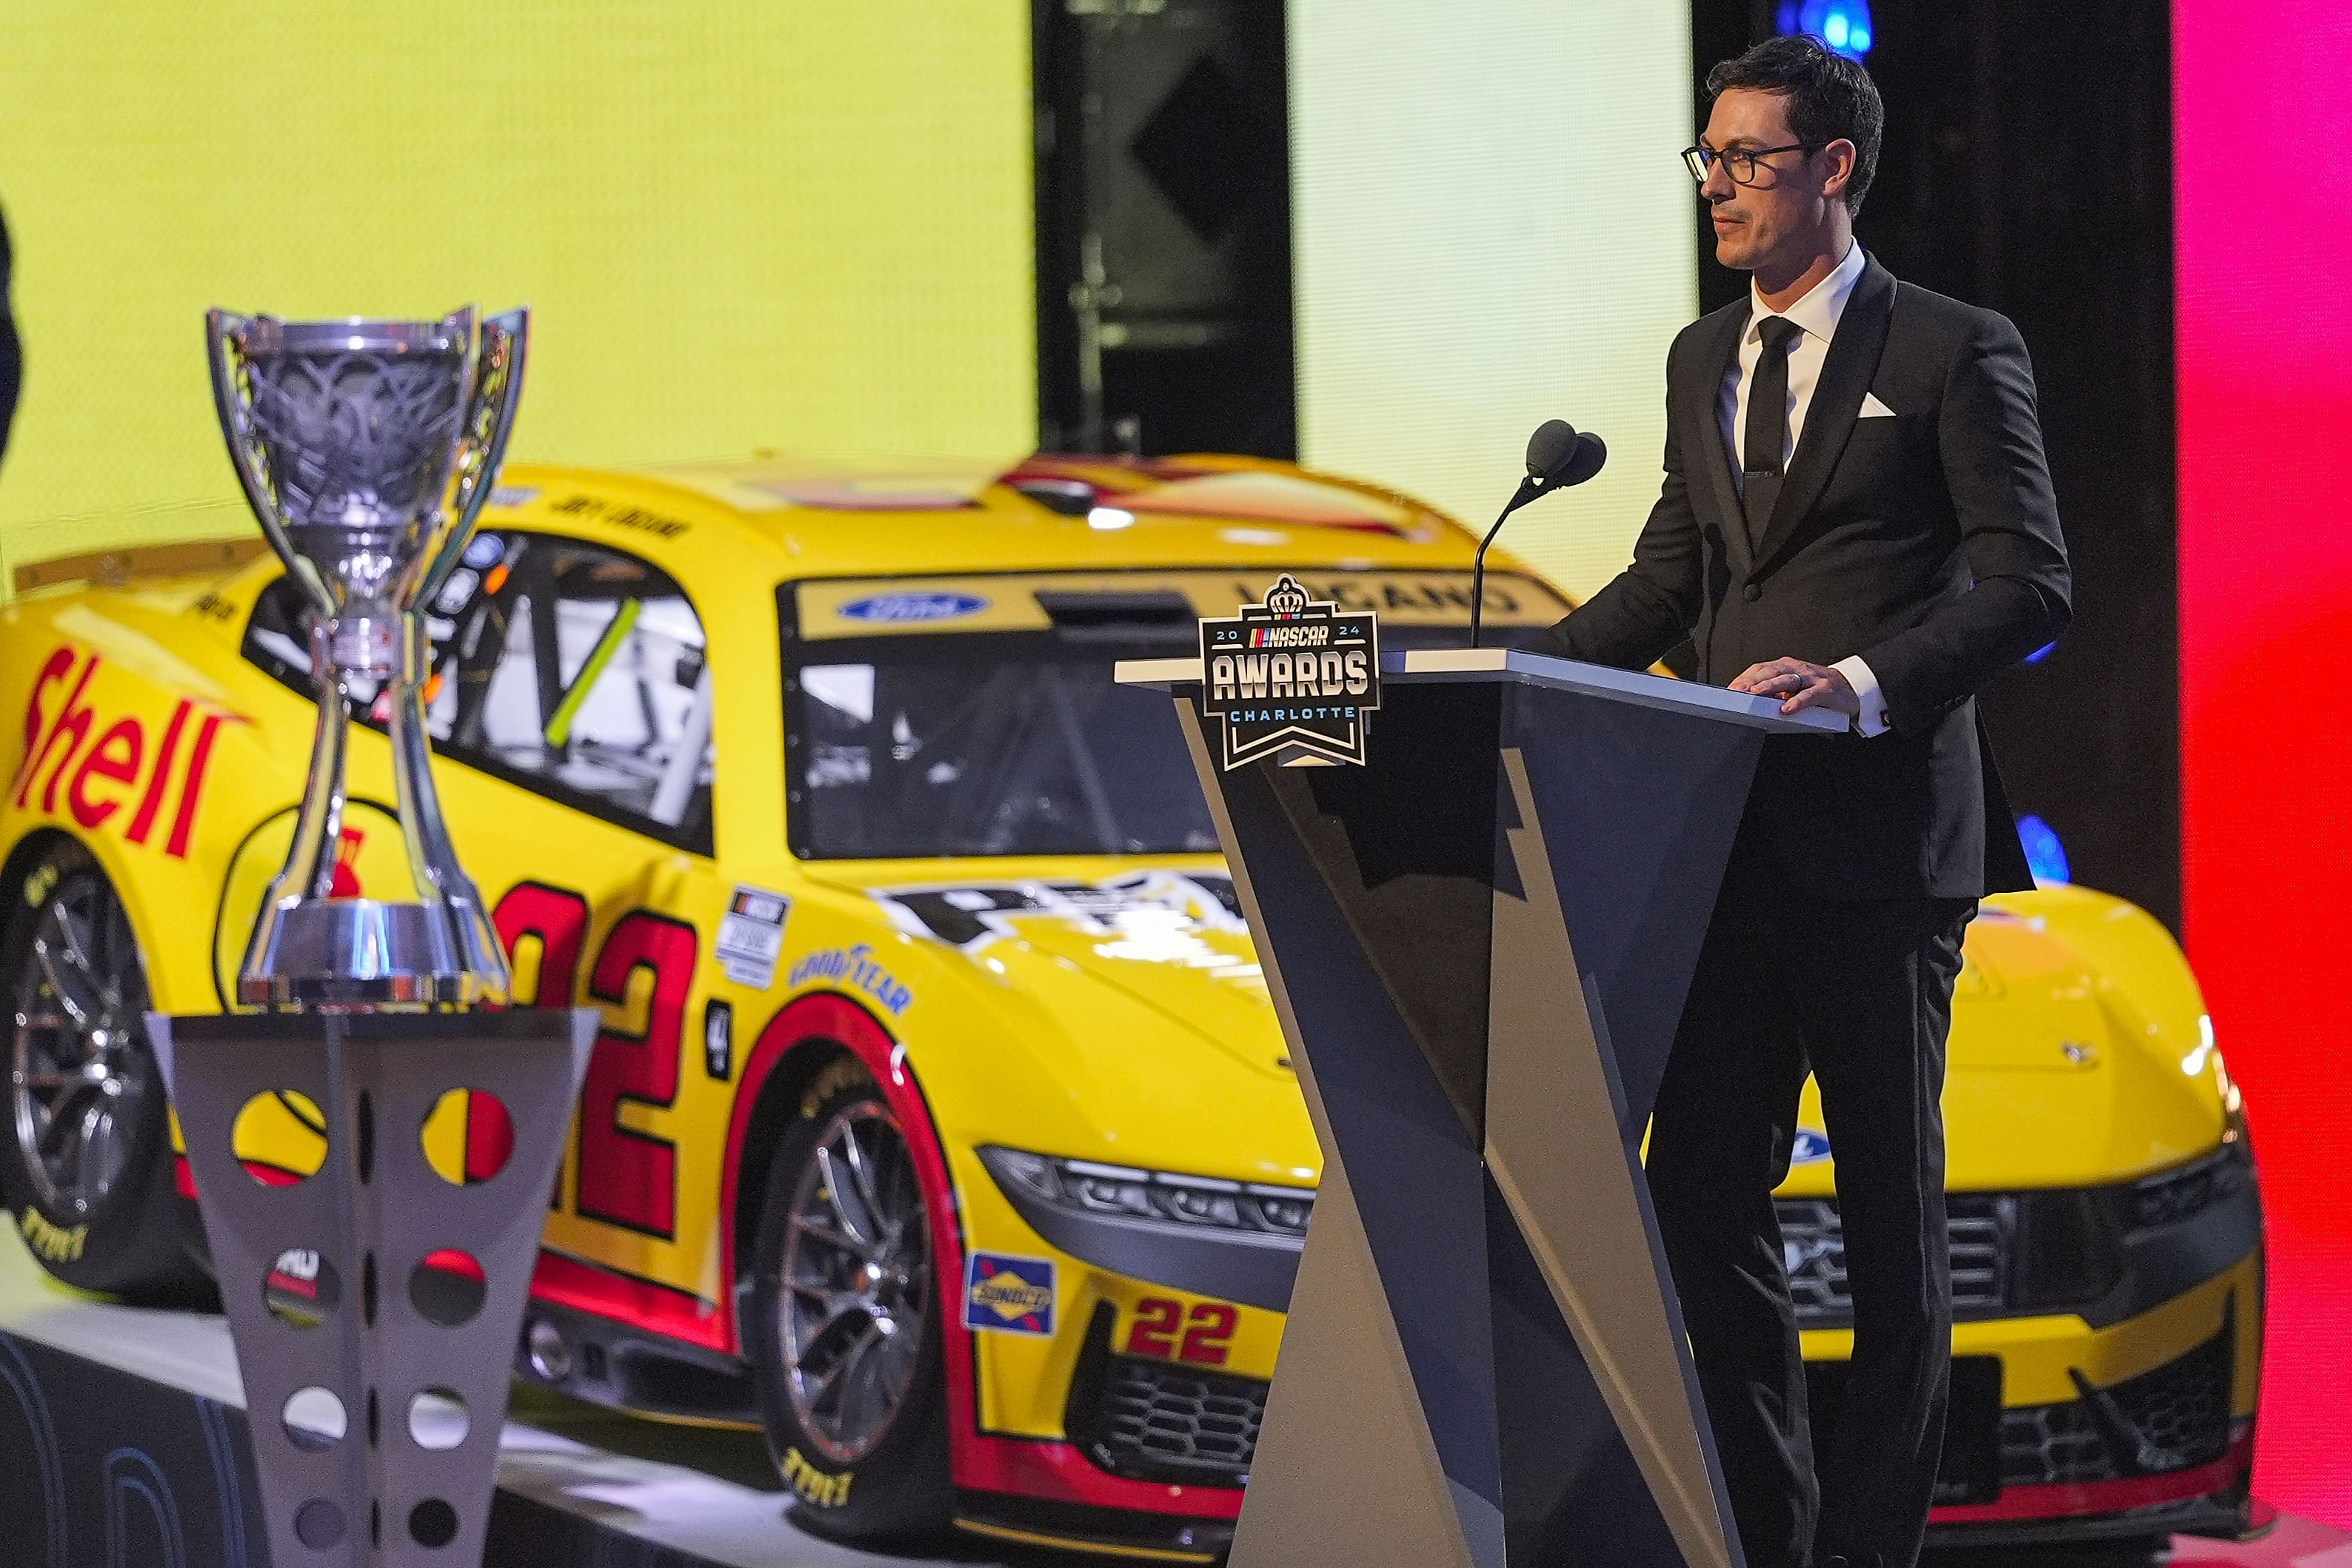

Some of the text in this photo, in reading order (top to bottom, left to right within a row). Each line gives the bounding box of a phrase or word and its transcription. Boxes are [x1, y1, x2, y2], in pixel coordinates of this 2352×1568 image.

[1216, 626, 1360, 648] 20 NASCAR 24
[1212, 650, 1369, 700] AWARDS
[1230, 706, 1355, 723] CHARLOTTE
[16, 646, 222, 860] Shell
[1129, 1297, 1238, 1364] 22
